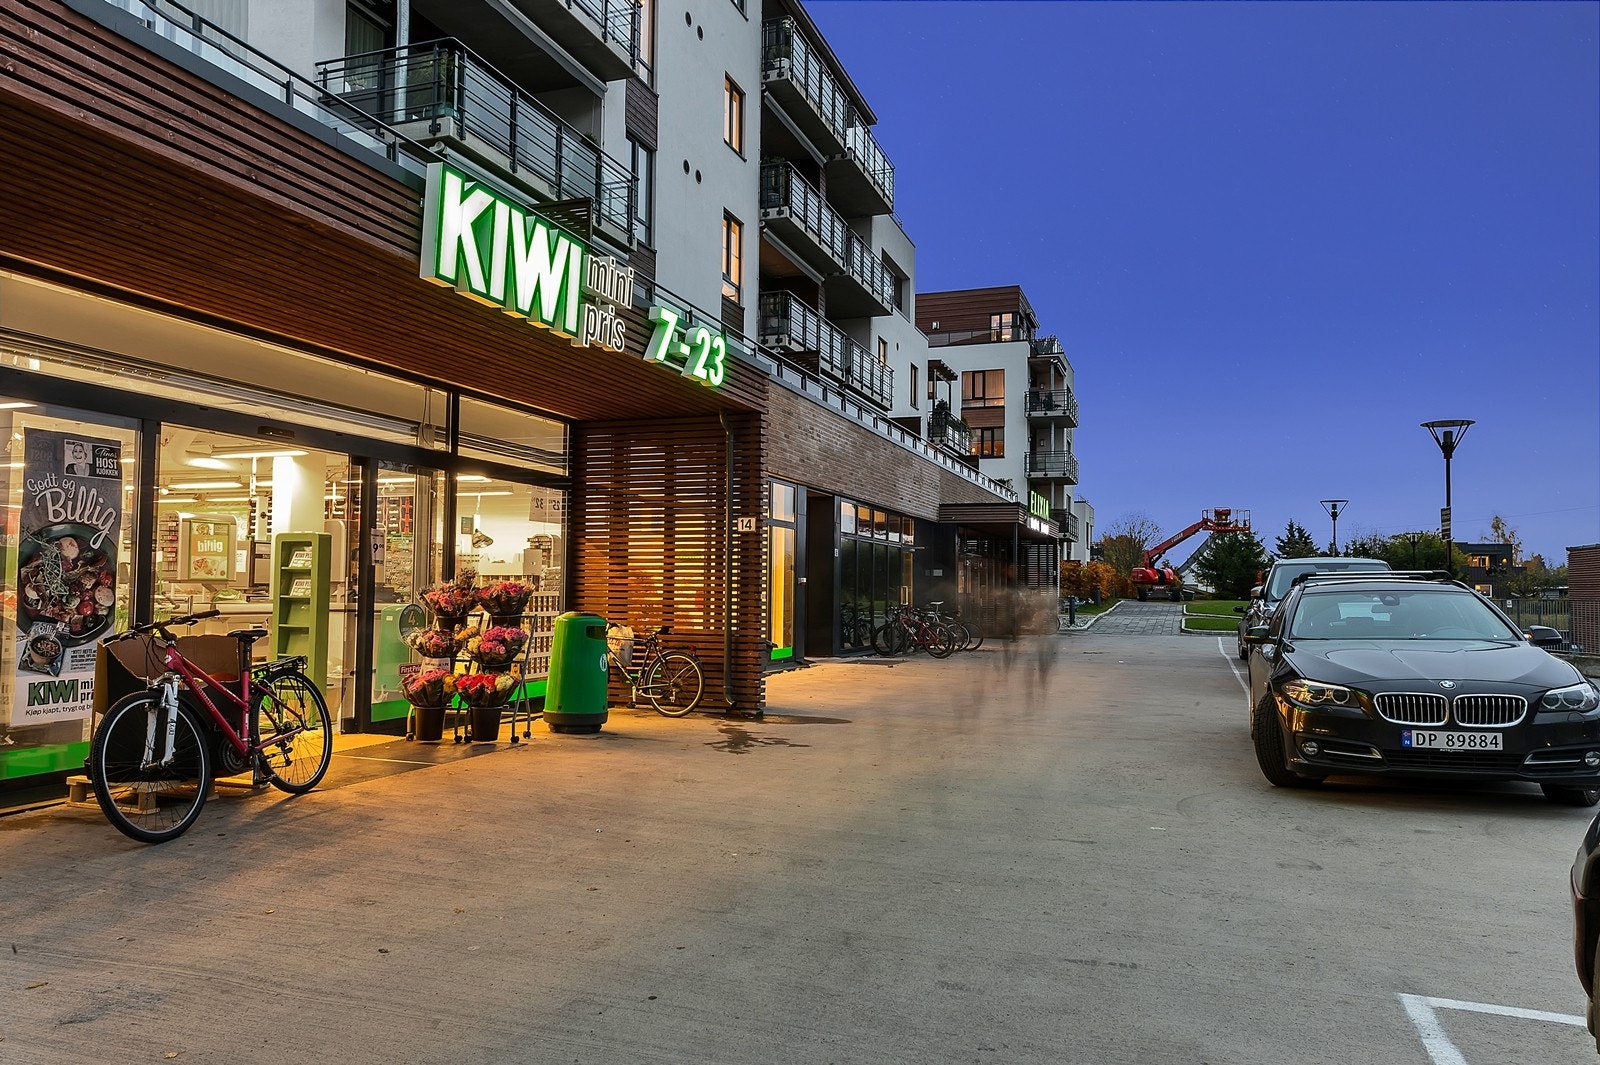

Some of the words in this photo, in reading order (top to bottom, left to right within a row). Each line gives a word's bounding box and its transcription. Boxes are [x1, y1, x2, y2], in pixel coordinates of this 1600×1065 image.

[436, 163, 585, 338] KIWI
[587, 254, 634, 309] mini
[583, 303, 625, 352] pris
[27, 472, 59, 495] Godt
[62, 479, 75, 498] og
[35, 486, 116, 549] Billig
[741, 519, 752, 530] 14
[197, 539, 223, 552] billig
[27, 679, 79, 706] KIWI
[80, 678, 93, 689] mi
[80, 689, 94, 703] pri
[1416, 733, 1437, 746] DP
[1446, 734, 1499, 748] 89884
